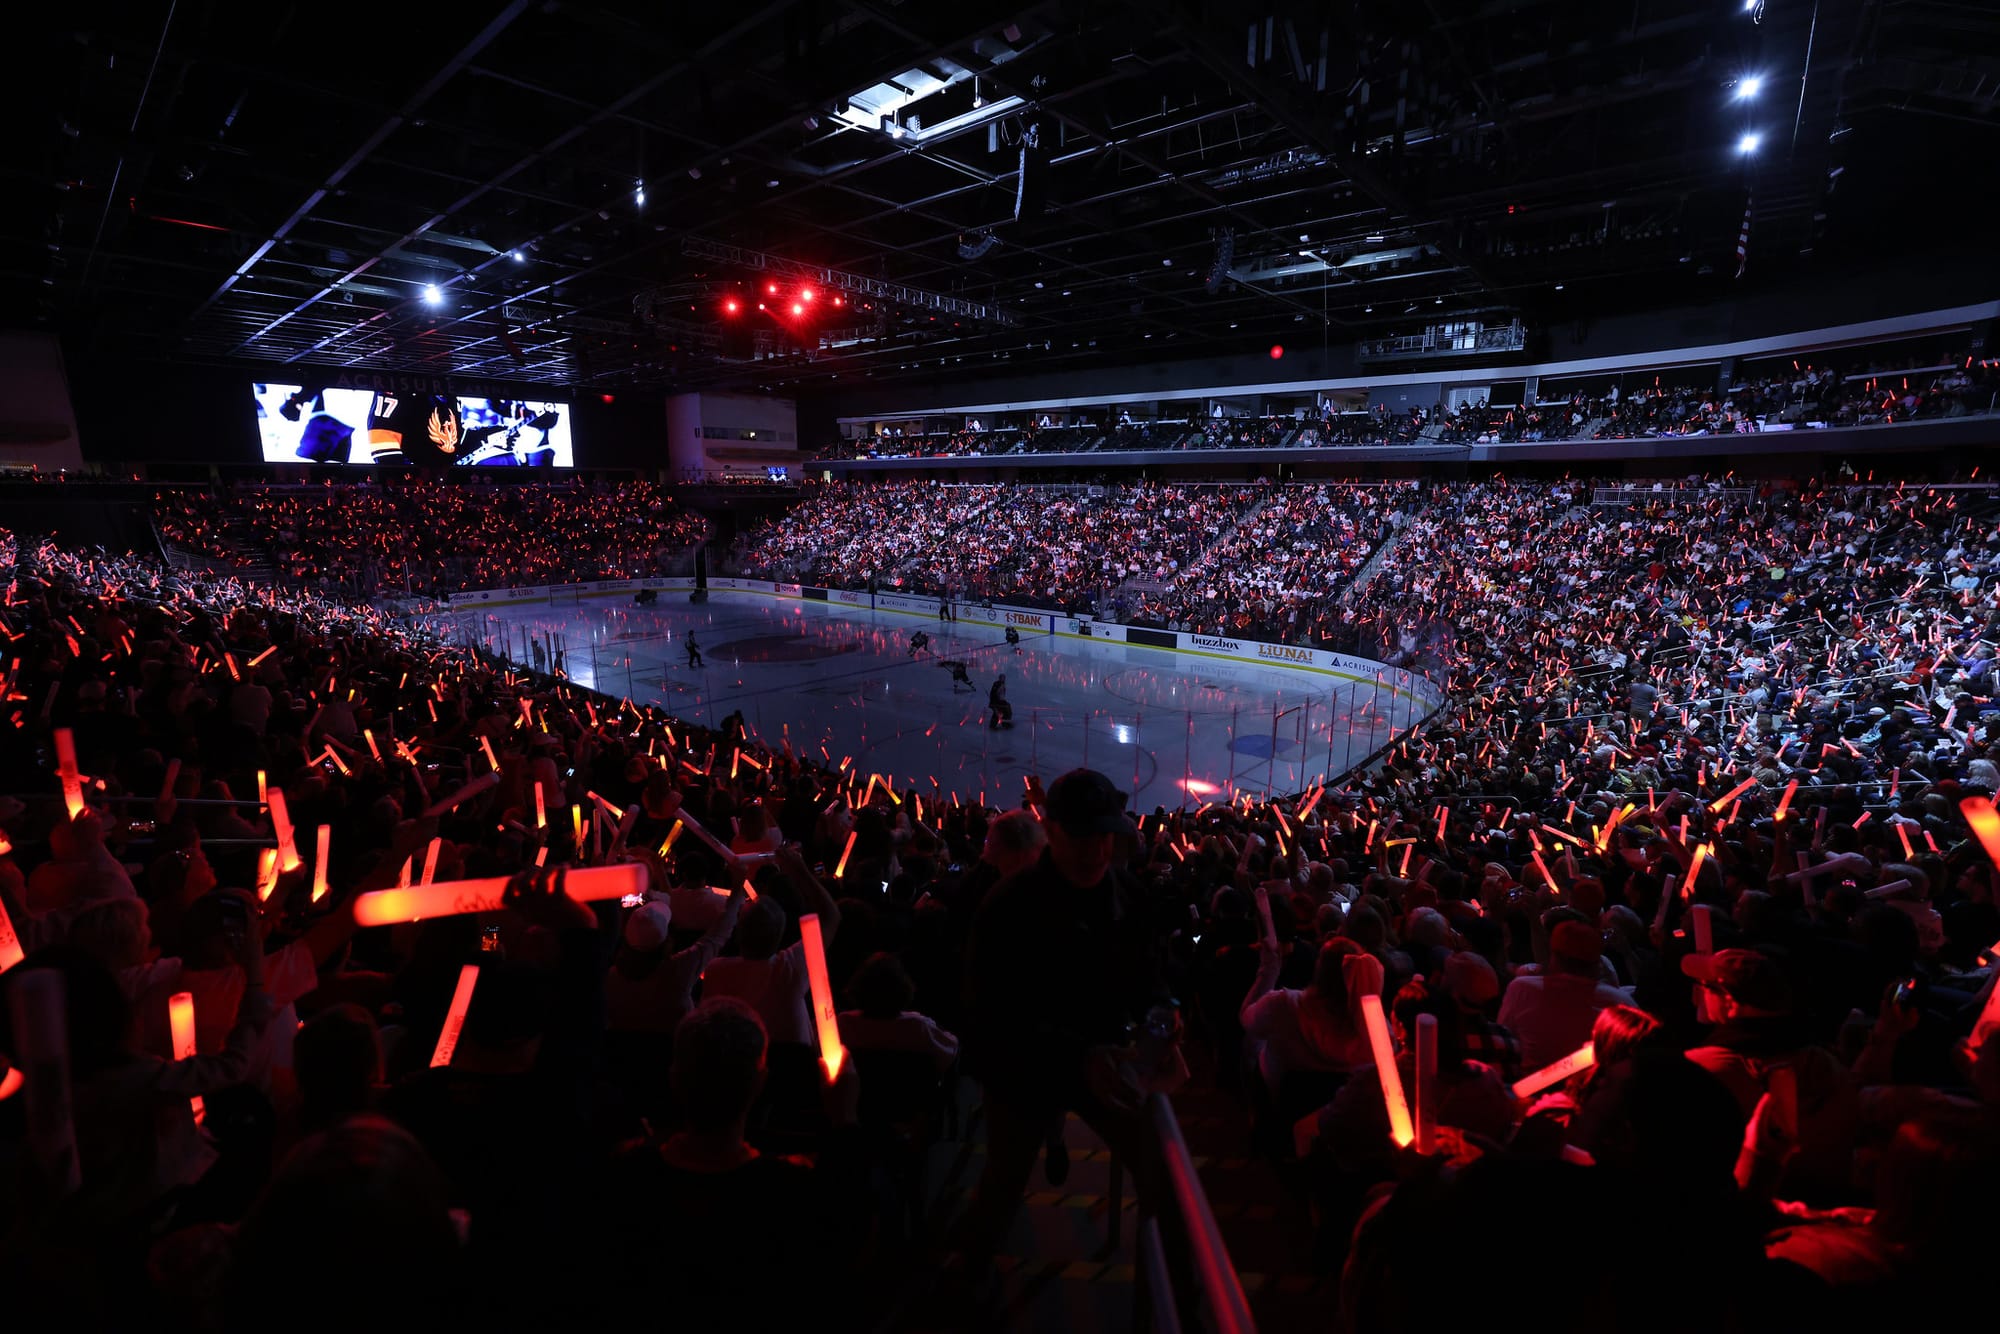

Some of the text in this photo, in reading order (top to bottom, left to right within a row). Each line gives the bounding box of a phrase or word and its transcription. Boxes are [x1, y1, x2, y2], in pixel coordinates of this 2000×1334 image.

[336, 373, 511, 397] ACRISURE ARENA
[374, 395, 399, 418] 17
[1191, 635, 1239, 650] buzzbox
